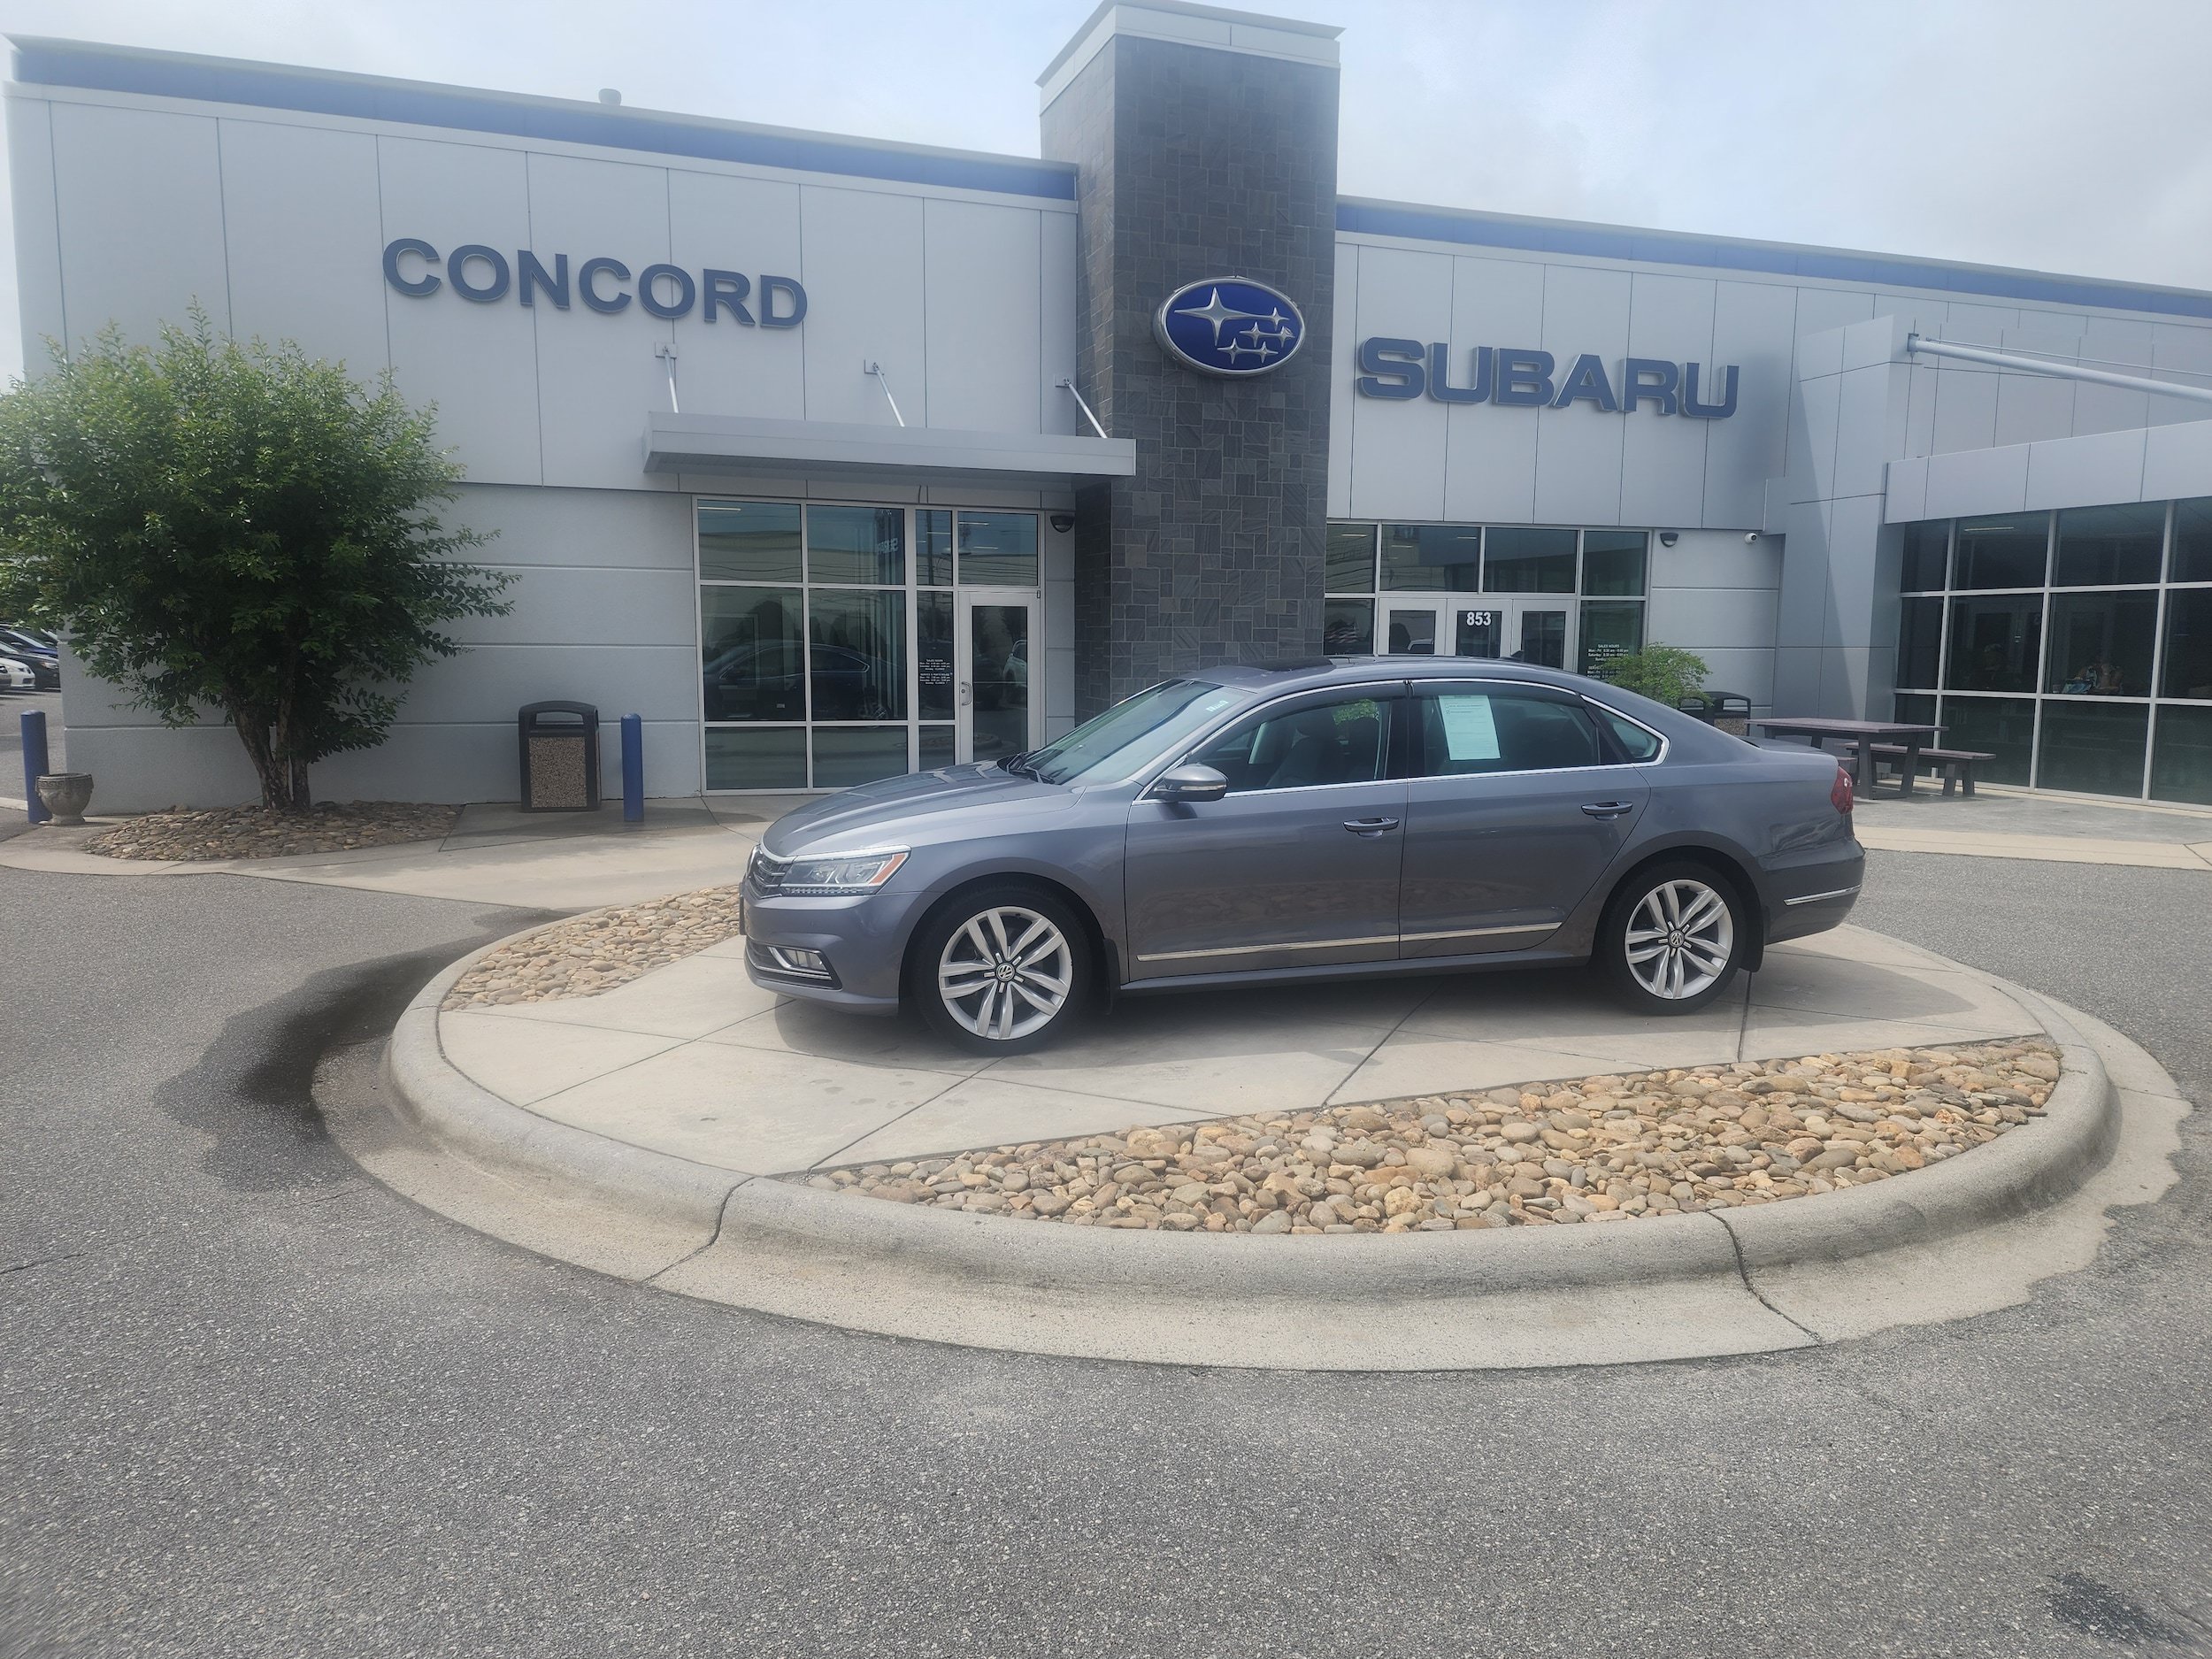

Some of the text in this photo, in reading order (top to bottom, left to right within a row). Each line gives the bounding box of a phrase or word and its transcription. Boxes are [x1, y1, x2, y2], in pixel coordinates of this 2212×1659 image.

[382, 238, 808, 328] CONCORD
[1356, 336, 1740, 419] SUBARU
[1466, 611, 1492, 626] 853
